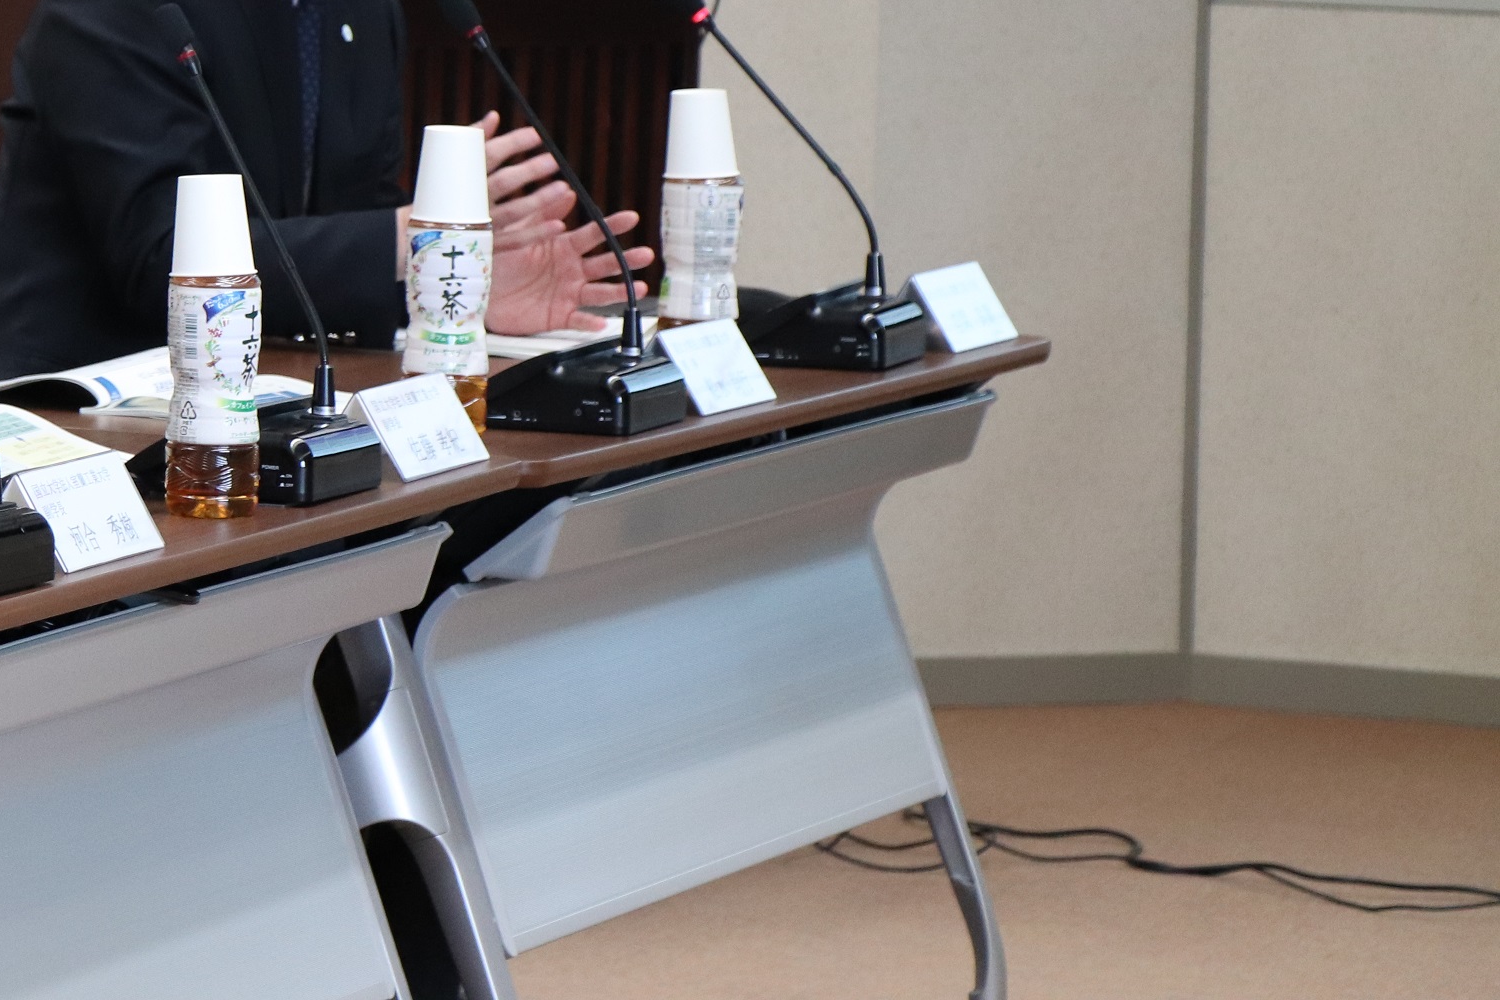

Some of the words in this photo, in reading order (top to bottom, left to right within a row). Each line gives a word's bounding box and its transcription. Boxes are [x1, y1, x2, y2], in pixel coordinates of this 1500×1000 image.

[439, 245, 468, 320] 十六茶
[241, 304, 259, 390] 十六茶
